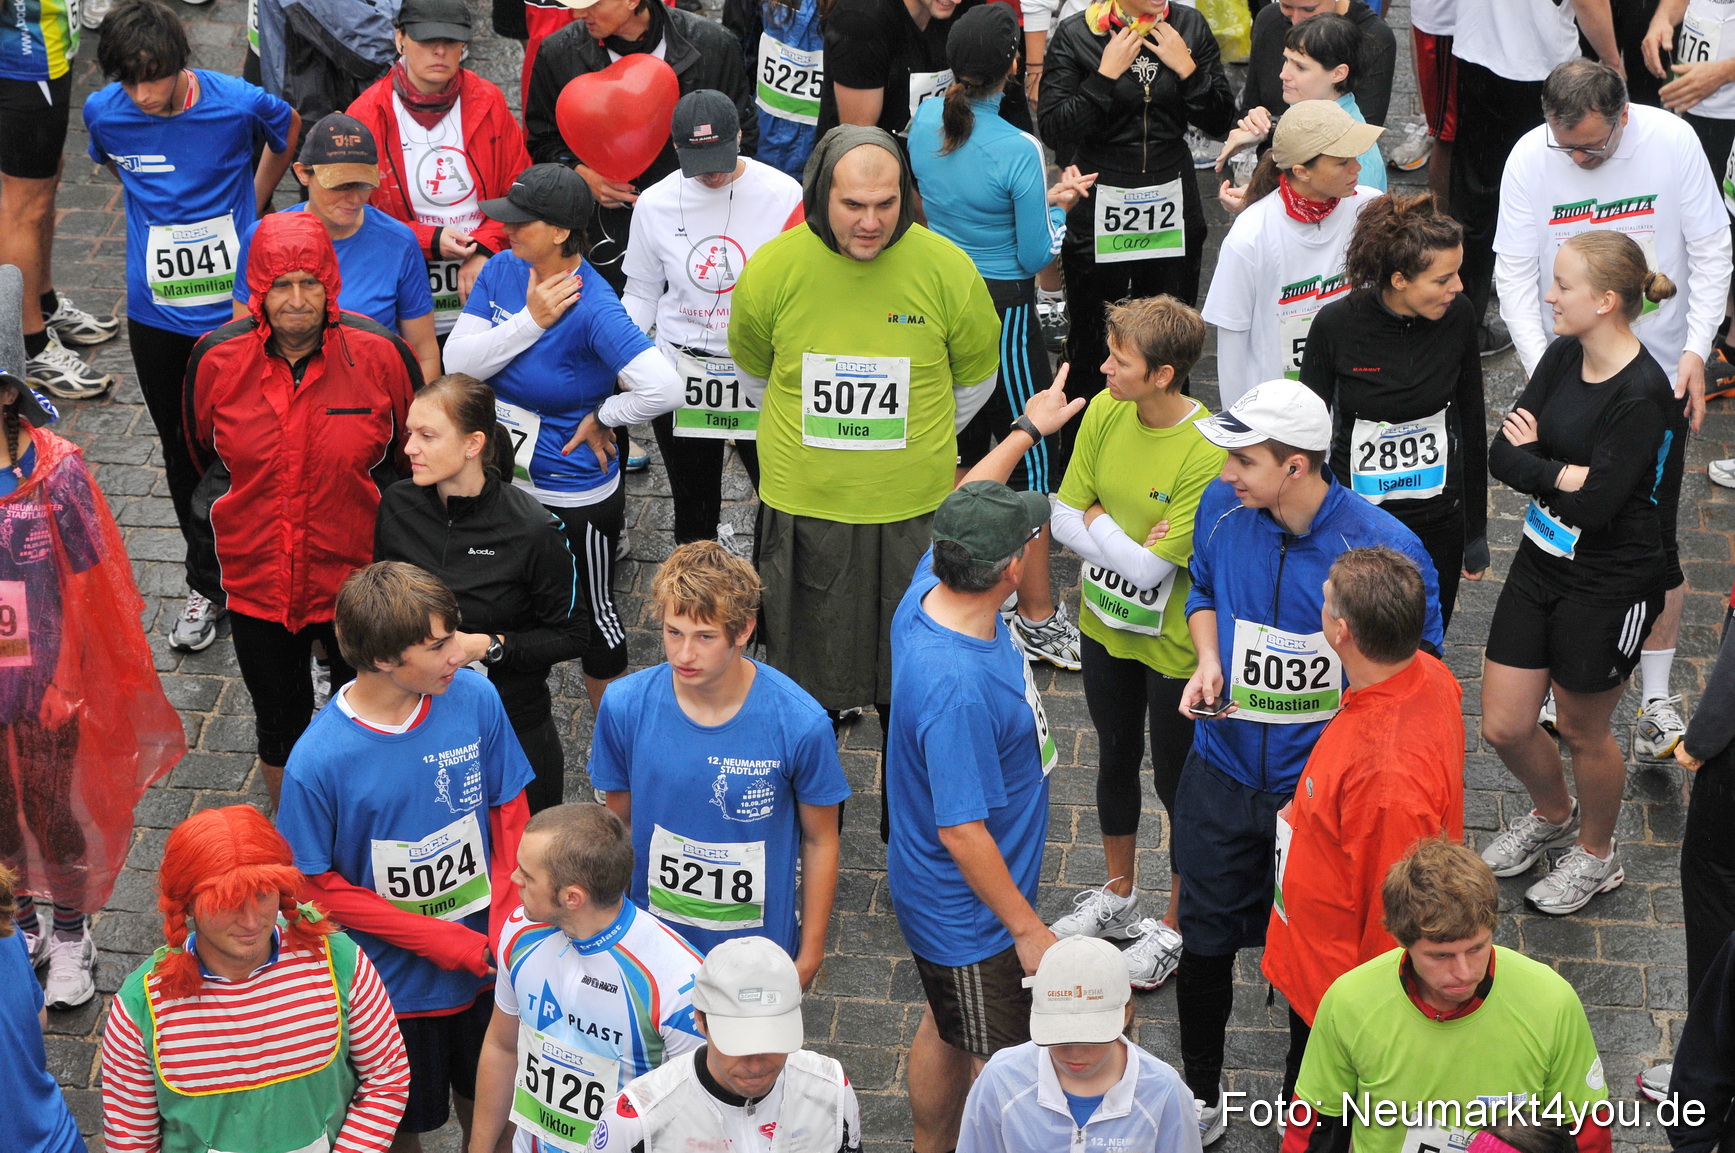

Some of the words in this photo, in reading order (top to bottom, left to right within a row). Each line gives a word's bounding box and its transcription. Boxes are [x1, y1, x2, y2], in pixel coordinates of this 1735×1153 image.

[763, 56, 823, 98] 5225
[417, 214, 445, 225] UFEN
[449, 214, 466, 225] MIT
[1104, 201, 1175, 232] 5212
[1596, 197, 1653, 219] ITALIA
[1112, 234, 1151, 251] Caro
[156, 239, 232, 279] 5041
[163, 278, 234, 297] Maximilian
[429, 263, 459, 293] 50
[679, 304, 713, 318] LAUFEN
[716, 307, 730, 317] MI
[705, 362, 735, 372] BOC
[835, 361, 877, 373] BOCK
[685, 376, 757, 409] 501
[813, 379, 899, 415] 5074
[705, 413, 739, 429] Tanja
[838, 422, 870, 437] Ivica
[1358, 432, 1440, 472] 2893
[1378, 473, 1422, 492] Isabell
[1528, 509, 1556, 541] Simone
[1100, 593, 1130, 619] Ulrike
[1266, 633, 1307, 650] BOCK
[1243, 648, 1331, 692] 5032
[1249, 693, 1320, 711] Sebastian
[423, 753, 438, 764] 12.
[438, 741, 481, 760] NEUMARK
[438, 749, 480, 768] STADTLAU
[707, 756, 722, 765] 12.
[720, 765, 771, 776] STADTLAUF
[740, 797, 775, 808] 18.09.2011
[409, 833, 449, 858] BOCK
[683, 843, 729, 859] BOCK
[387, 842, 477, 898] 5024
[659, 854, 754, 903] 5218
[419, 896, 456, 917] Timo
[579, 923, 623, 951] tr-plast
[568, 1013, 624, 1046] PLAST
[542, 1041, 583, 1066] BOCK
[525, 1051, 605, 1121] 5126
[539, 1107, 576, 1138] Viktor
